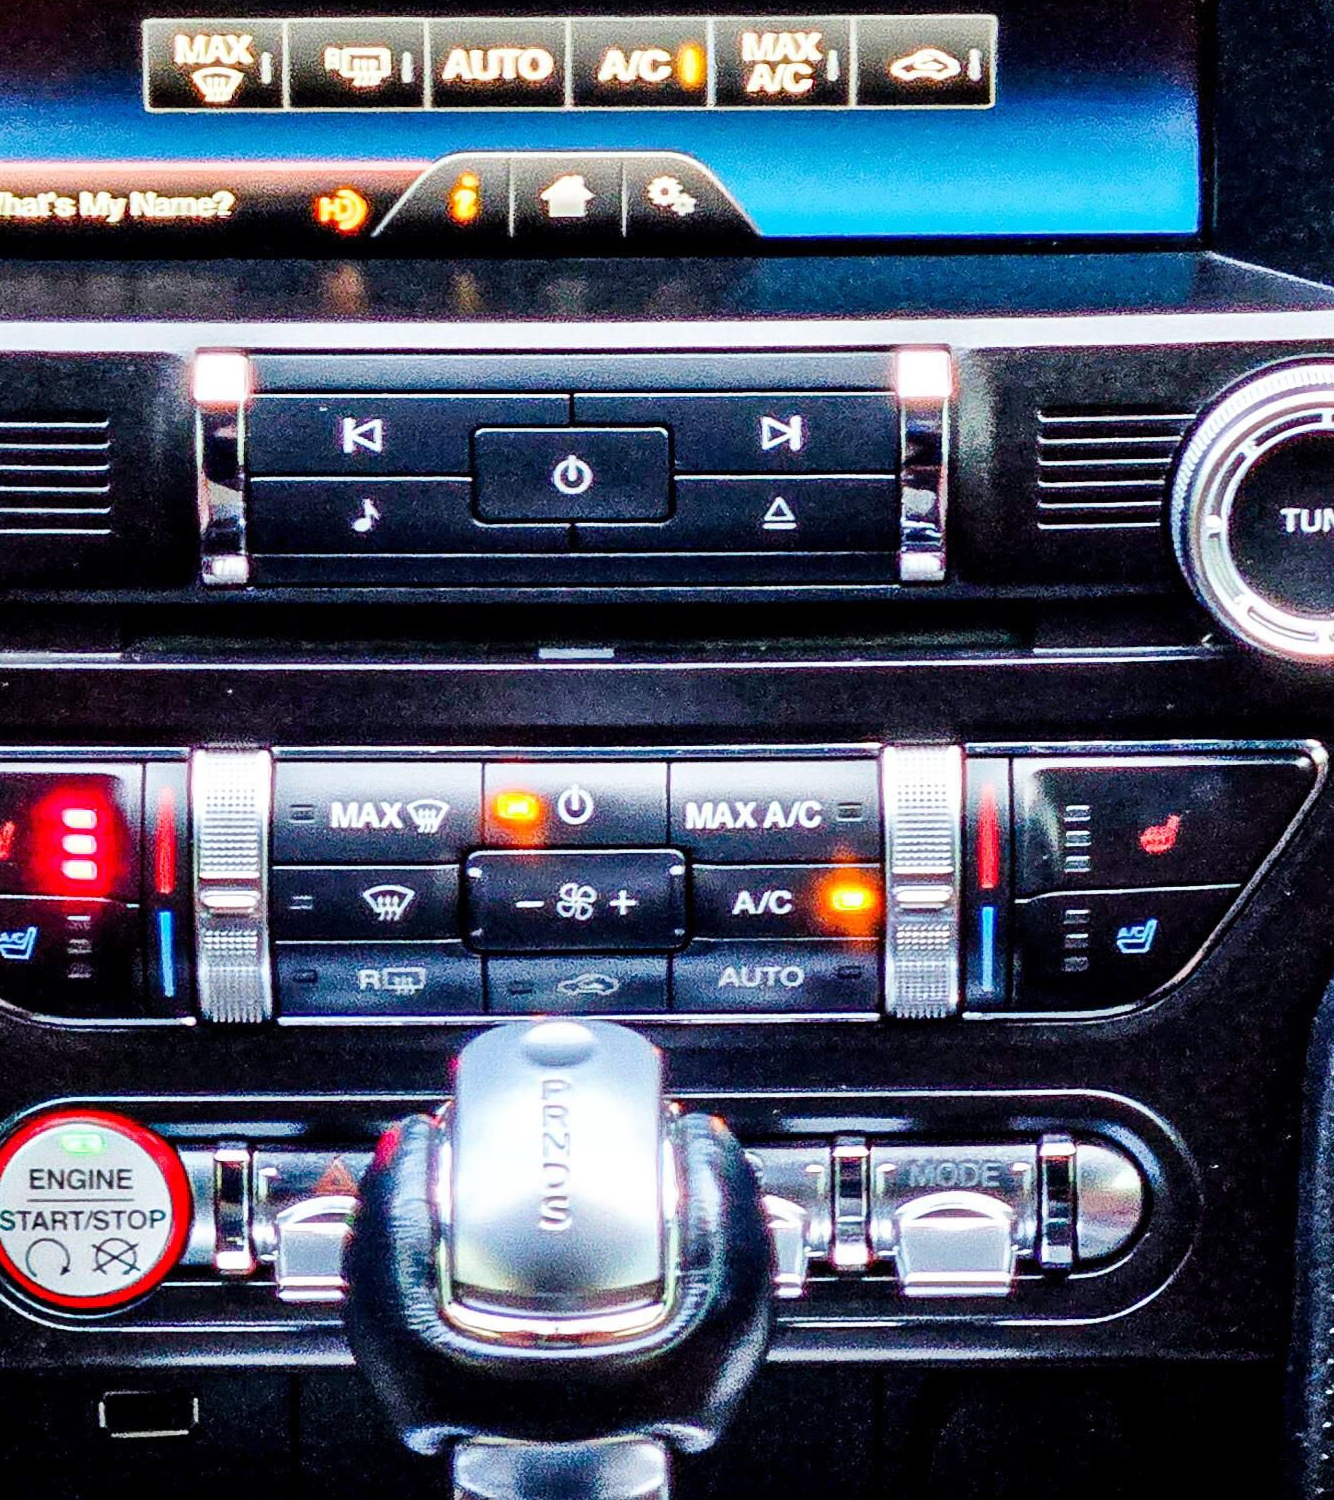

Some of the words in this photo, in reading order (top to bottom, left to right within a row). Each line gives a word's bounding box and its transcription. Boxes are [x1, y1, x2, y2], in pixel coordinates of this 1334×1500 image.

[174, 34, 254, 66] MAX
[741, 31, 823, 63] MAX
[442, 48, 555, 82] AUTO
[597, 49, 672, 83] A/C
[746, 63, 815, 95] A/C
[78, 191, 128, 223] My
[130, 190, 235, 218] Name?
[330, 801, 402, 830] MAX
[685, 801, 755, 830] MAX
[763, 801, 822, 830] A/C
[733, 890, 792, 916] A/C
[718, 965, 805, 989] AUTO
[28, 1168, 134, 1190] ENGINE
[909, 1161, 1002, 1189] MODE
